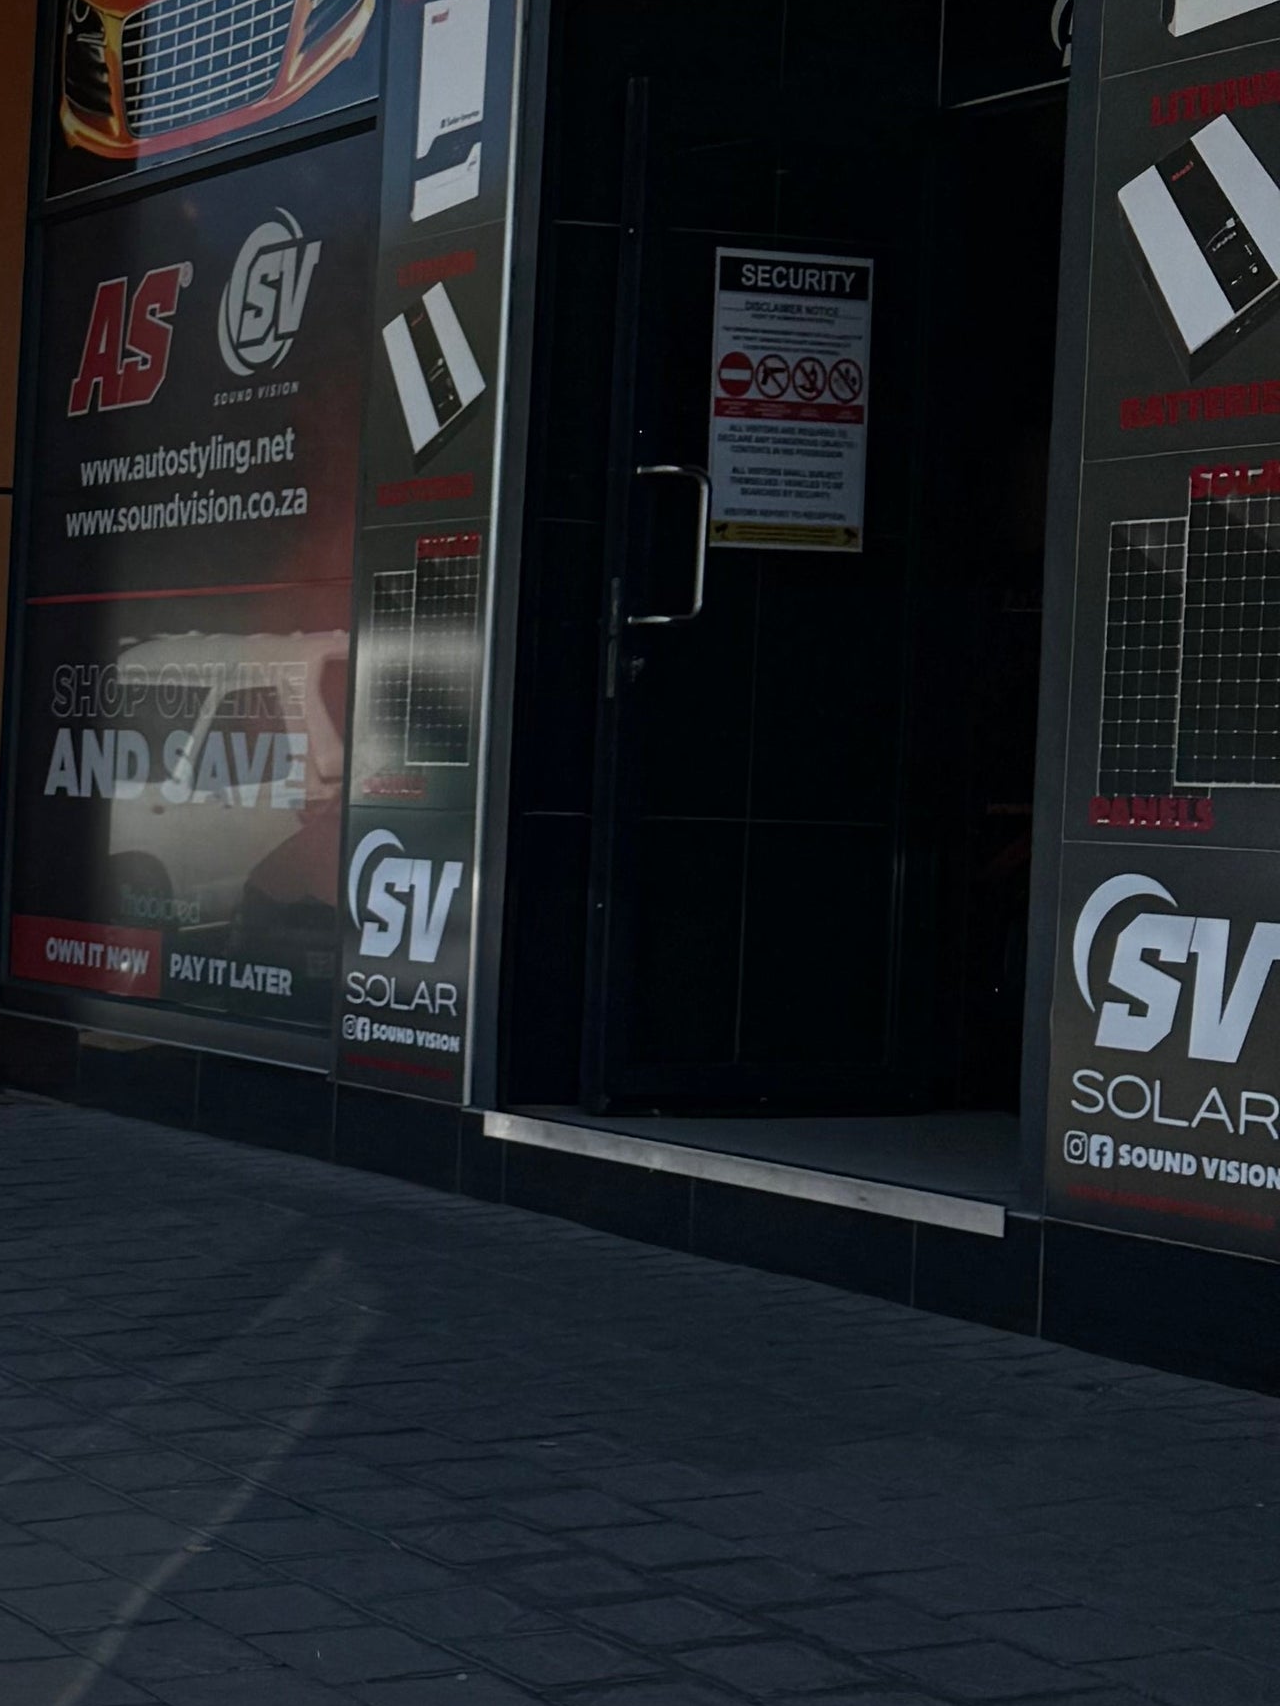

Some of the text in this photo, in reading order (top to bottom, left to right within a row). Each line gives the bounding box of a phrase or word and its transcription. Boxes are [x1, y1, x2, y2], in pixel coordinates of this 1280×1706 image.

[741, 263, 857, 293] SECURITY
[213, 381, 300, 407] SOUND VISION
[80, 427, 296, 487] www.autostyling.net
[66, 486, 309, 538] www.soundvision.co.za
[51, 661, 308, 720] SHOP ONLINE
[43, 727, 308, 810] AND SAVE
[1088, 795, 1214, 830] PANELS
[359, 857, 464, 963] SV
[45, 936, 151, 976] OWN IT NOW
[169, 953, 209, 983] PAY
[209, 957, 228, 985] IT
[229, 961, 293, 996] LATER
[346, 971, 458, 1017] SOLAR
[371, 1021, 460, 1054] SOUND VISION
[1071, 1069, 1280, 1141] SOLAR
[1118, 1144, 1198, 1176] SOUND
